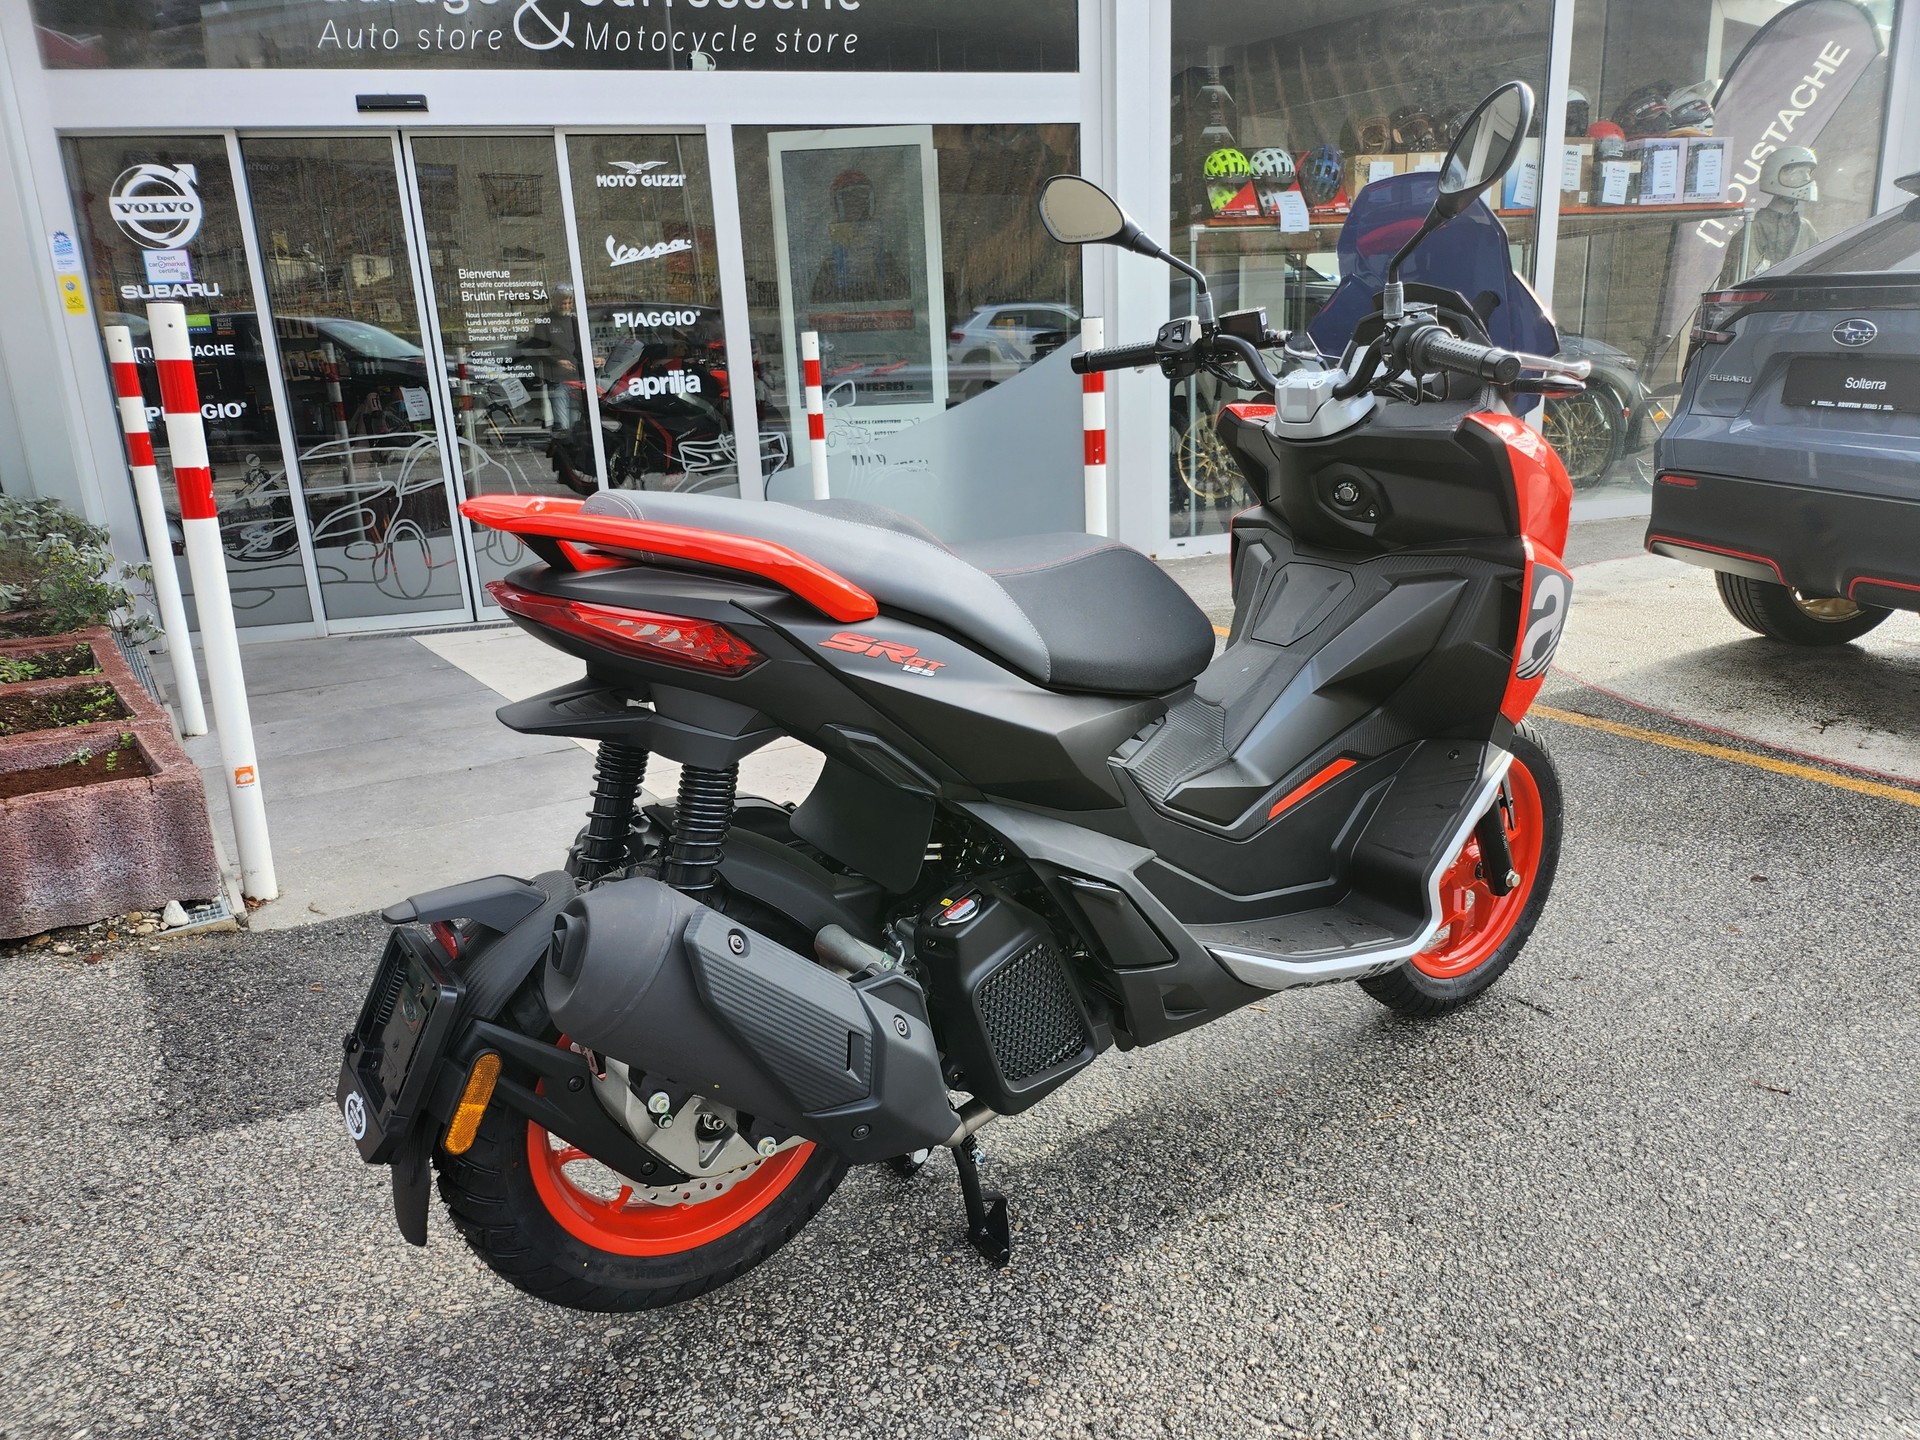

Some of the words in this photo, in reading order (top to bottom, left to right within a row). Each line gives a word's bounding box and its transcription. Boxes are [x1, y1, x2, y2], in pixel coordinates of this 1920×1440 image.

[317, 19, 399, 50] Auto
[417, 23, 503, 50] store
[585, 22, 757, 58] Motocycle
[775, 28, 859, 53] store
[596, 174, 637, 187] MOTO
[641, 174, 684, 187] GUZZI
[115, 202, 194, 214] VOLVO
[605, 235, 692, 267] Vespa
[458, 268, 511, 279] Bienvenue
[493, 280, 544, 288] concessionnaire
[461, 290, 496, 302] Bruttin
[498, 290, 531, 301] Frères
[532, 289, 549, 300] SA
[612, 310, 697, 328] PIAGGIO
[628, 369, 702, 399] aprilia
[1709, 373, 1753, 384] SUBARU
[1844, 376, 1888, 391] Solterra
[901, 663, 936, 678] 125
